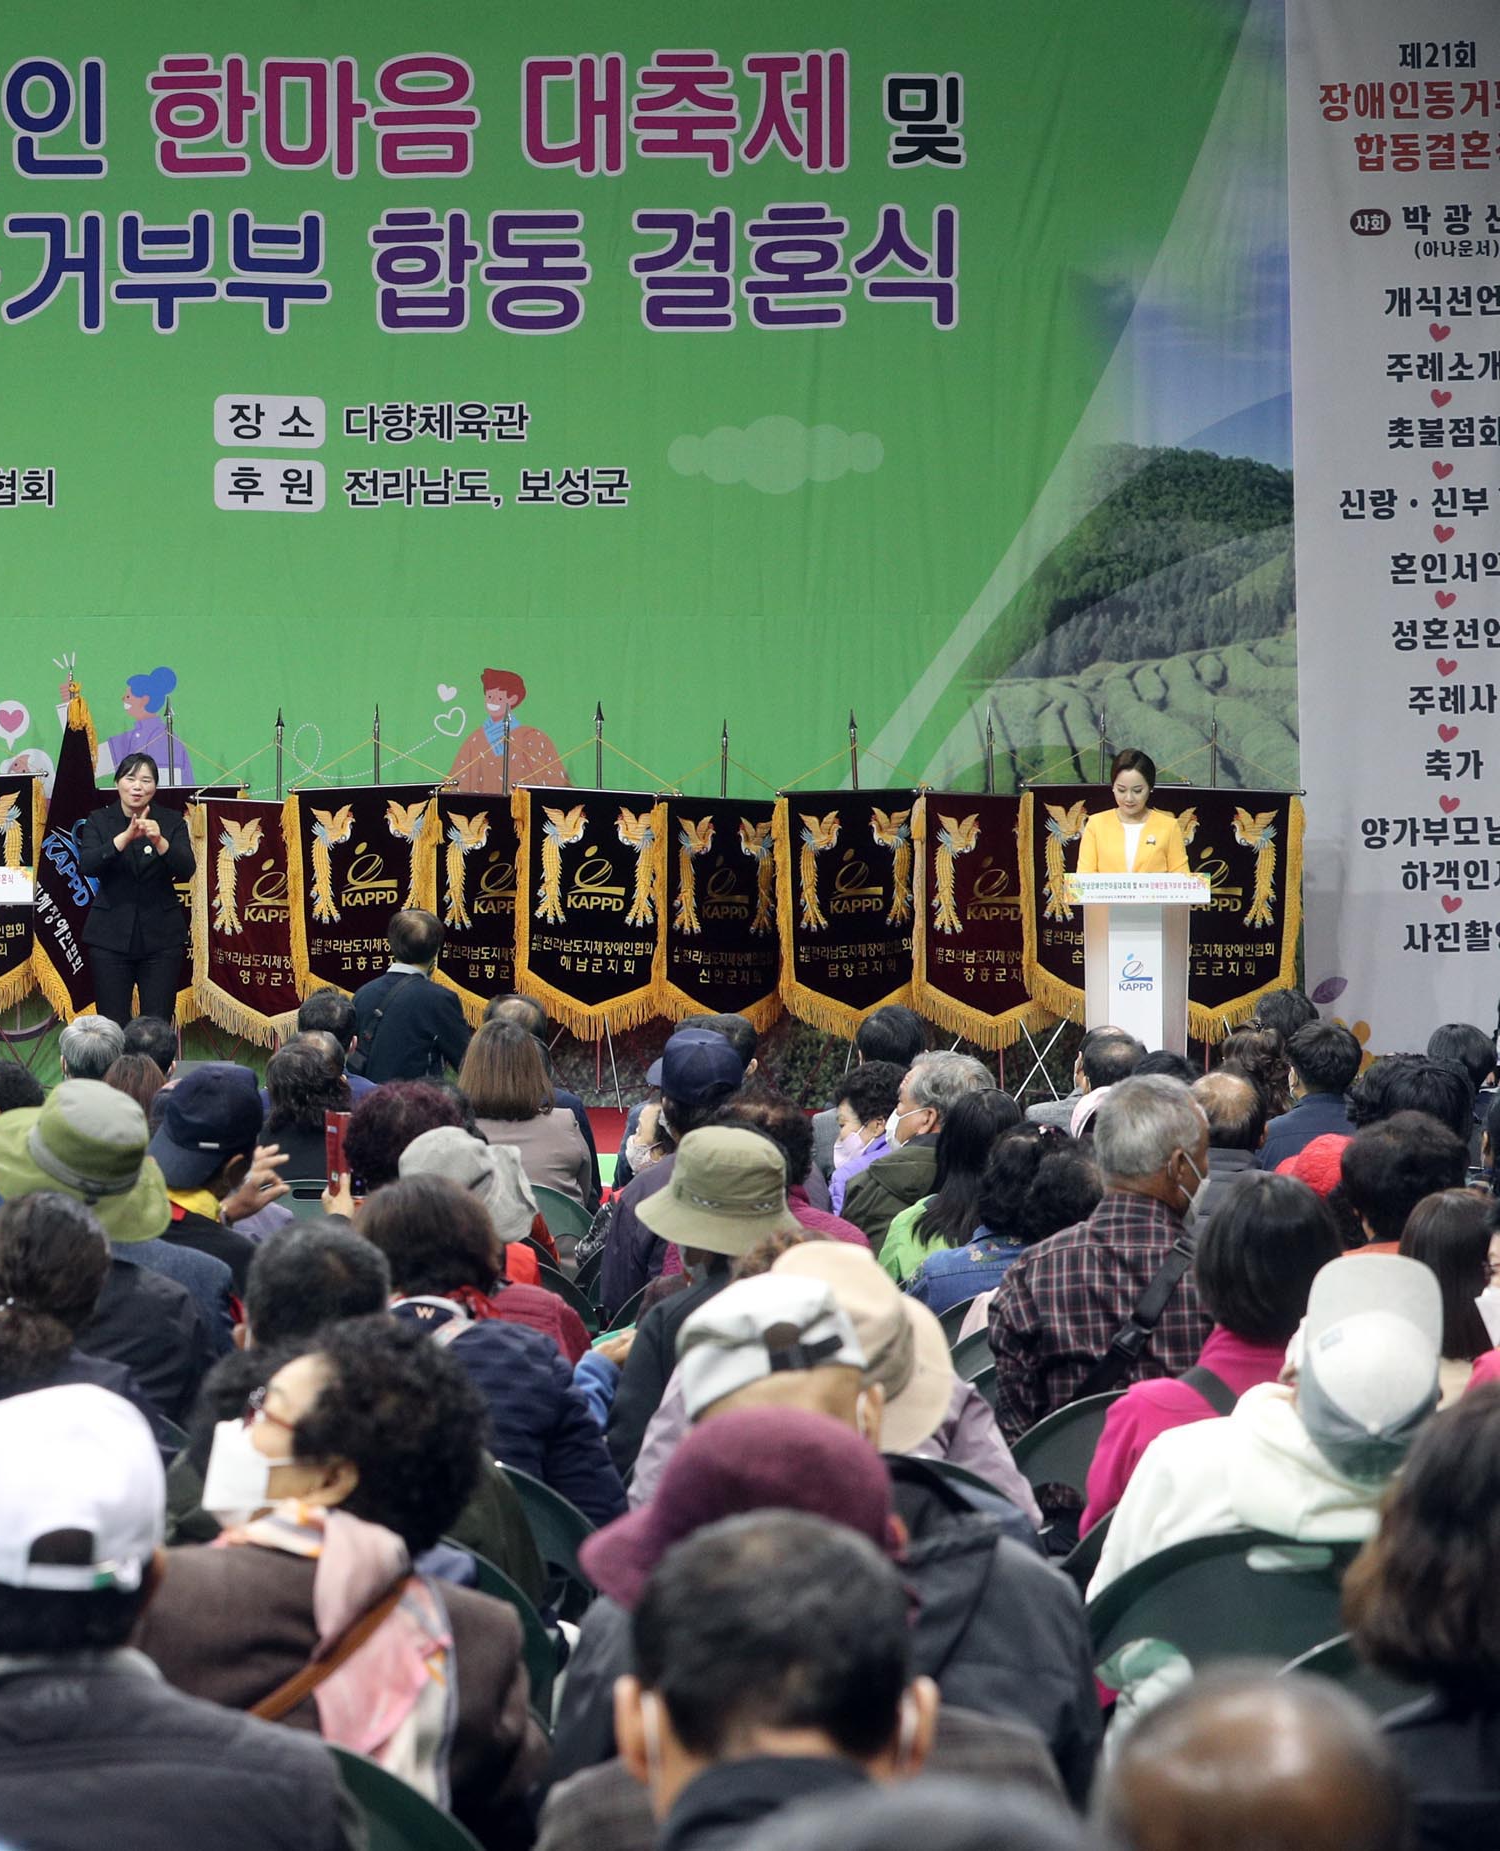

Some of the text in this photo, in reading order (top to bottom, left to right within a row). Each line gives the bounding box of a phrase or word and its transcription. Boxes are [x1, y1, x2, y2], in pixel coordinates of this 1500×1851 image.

[1399, 41, 1476, 69] 제21회
[1319, 81, 1500, 122] 장애인동거
[146, 51, 480, 180] 한마음
[519, 47, 849, 177] 대축제
[883, 72, 966, 169] 및
[1354, 131, 1500, 172] 합동결혼
[1355, 215, 1385, 231] 사회
[1414, 239, 1499, 258] (아나운서)
[368, 208, 591, 335] 합동
[629, 202, 960, 333] 결혼식
[344, 402, 529, 443] 다향체육관
[343, 468, 502, 509] 전라남도,
[517, 467, 630, 507] 보성군
[1408, 684, 1498, 715] 주례사
[1425, 749, 1484, 781] 축가
[42, 833, 90, 907] KAPPD
[1401, 860, 1500, 890] 하객인
[341, 891, 398, 907] KAPPD
[473, 899, 516, 914] KAPP
[567, 895, 624, 912] KAPPD
[830, 898, 884, 914] KAPPD
[244, 907, 290, 923] KAPP
[702, 905, 748, 920] KAPPD
[967, 906, 1022, 921] KAPPD
[1190, 961, 1255, 977] 도군지회
[1118, 983, 1153, 991] KAPPD
